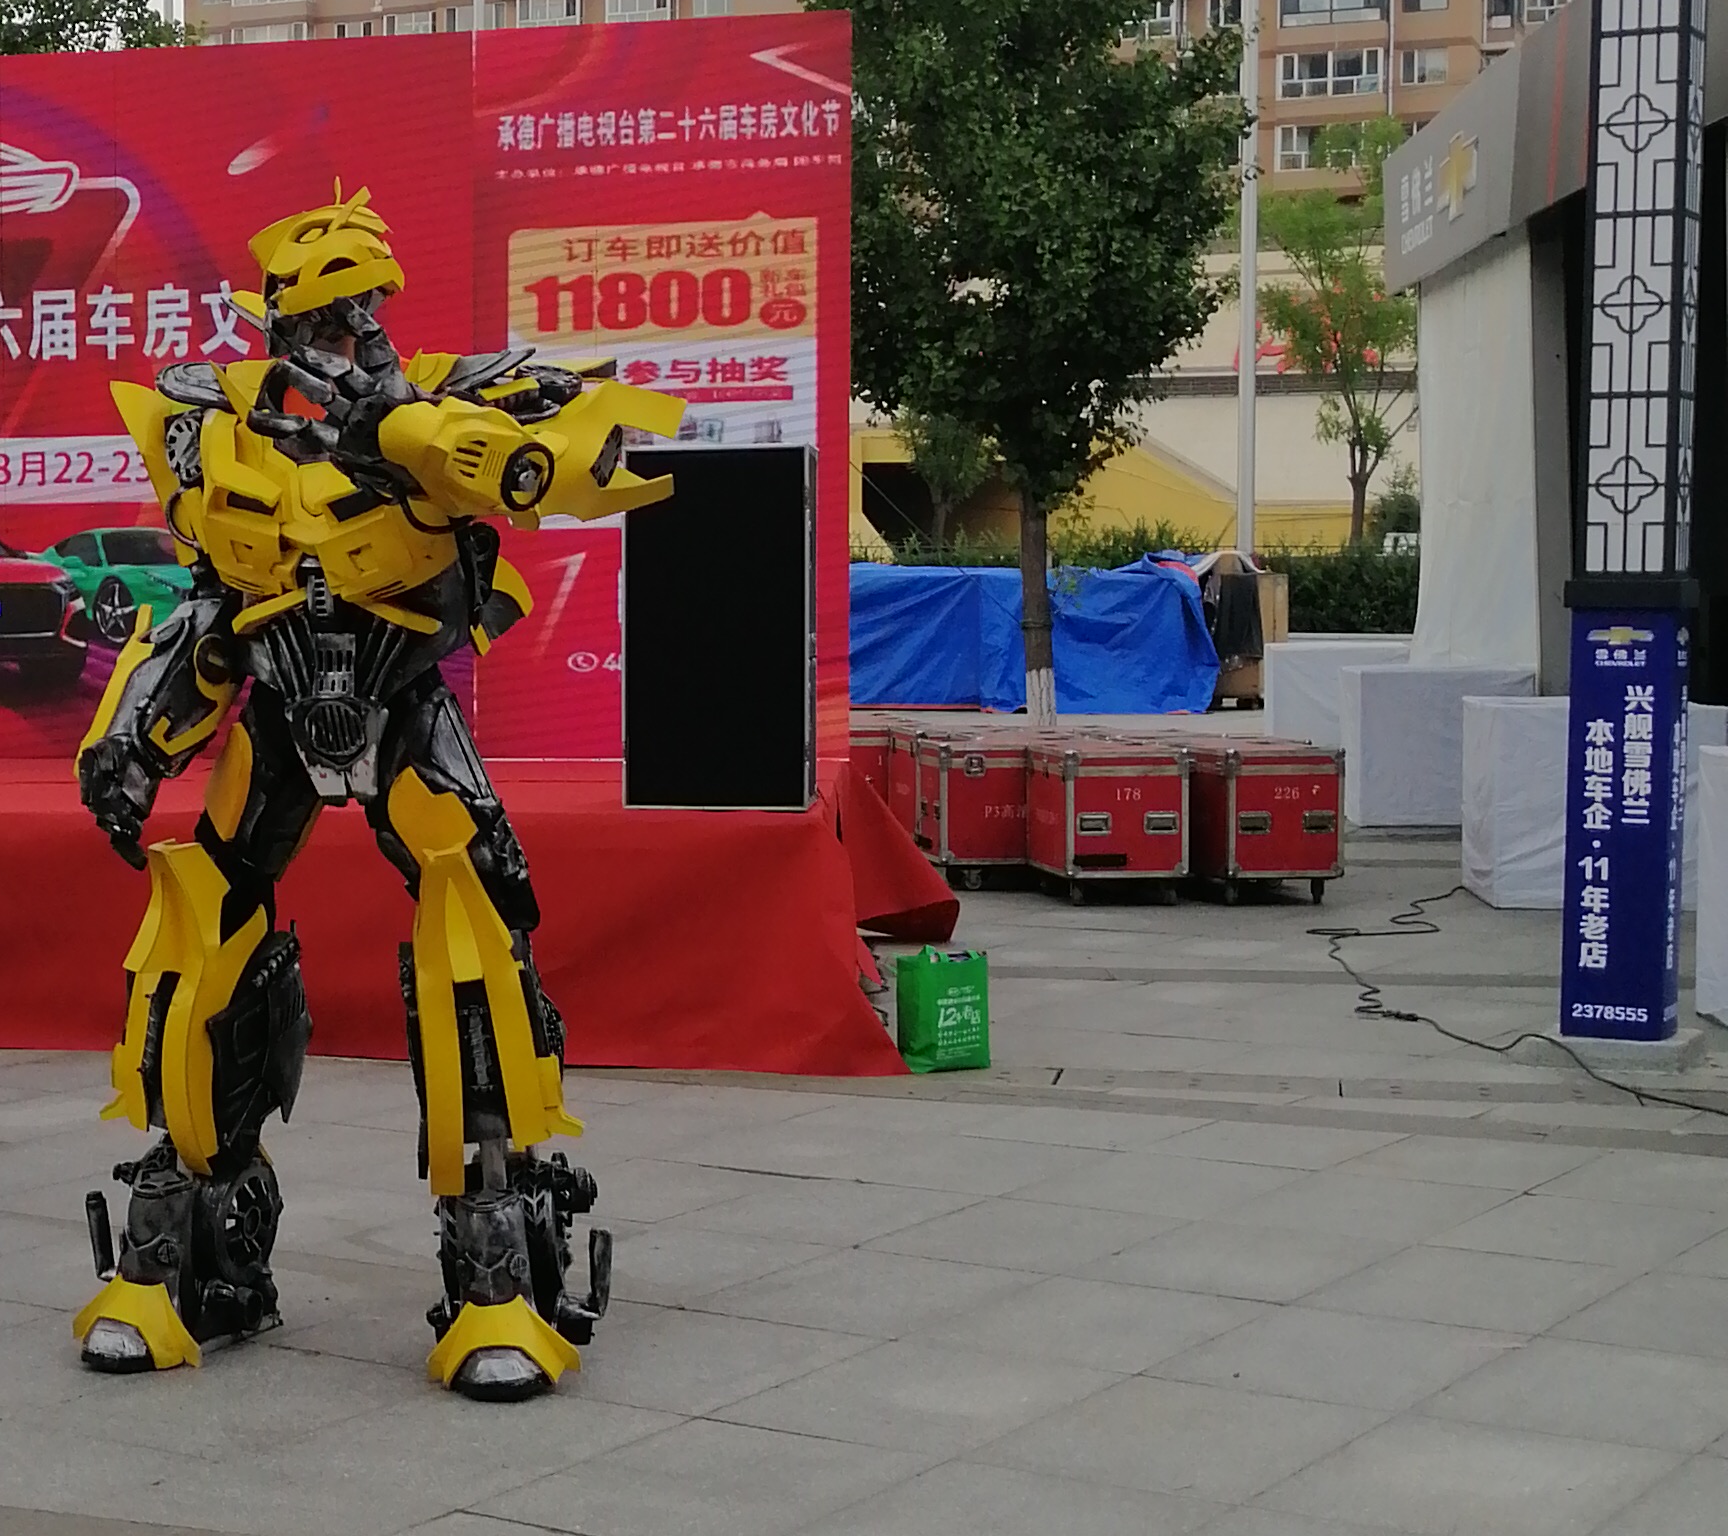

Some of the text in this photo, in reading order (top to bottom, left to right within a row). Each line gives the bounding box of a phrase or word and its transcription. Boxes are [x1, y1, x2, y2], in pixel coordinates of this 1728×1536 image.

[497, 98, 841, 152] 承德广播电视台第二十六届车房文化节
[564, 228, 809, 263] 订车即送价值
[524, 268, 752, 332] 11800
[1621, 684, 1655, 825] 兴舰雪佛兰
[1115, 788, 1141, 801] 178
[1274, 786, 1300, 800] 226
[1572, 1003, 1648, 1022] 2378555
